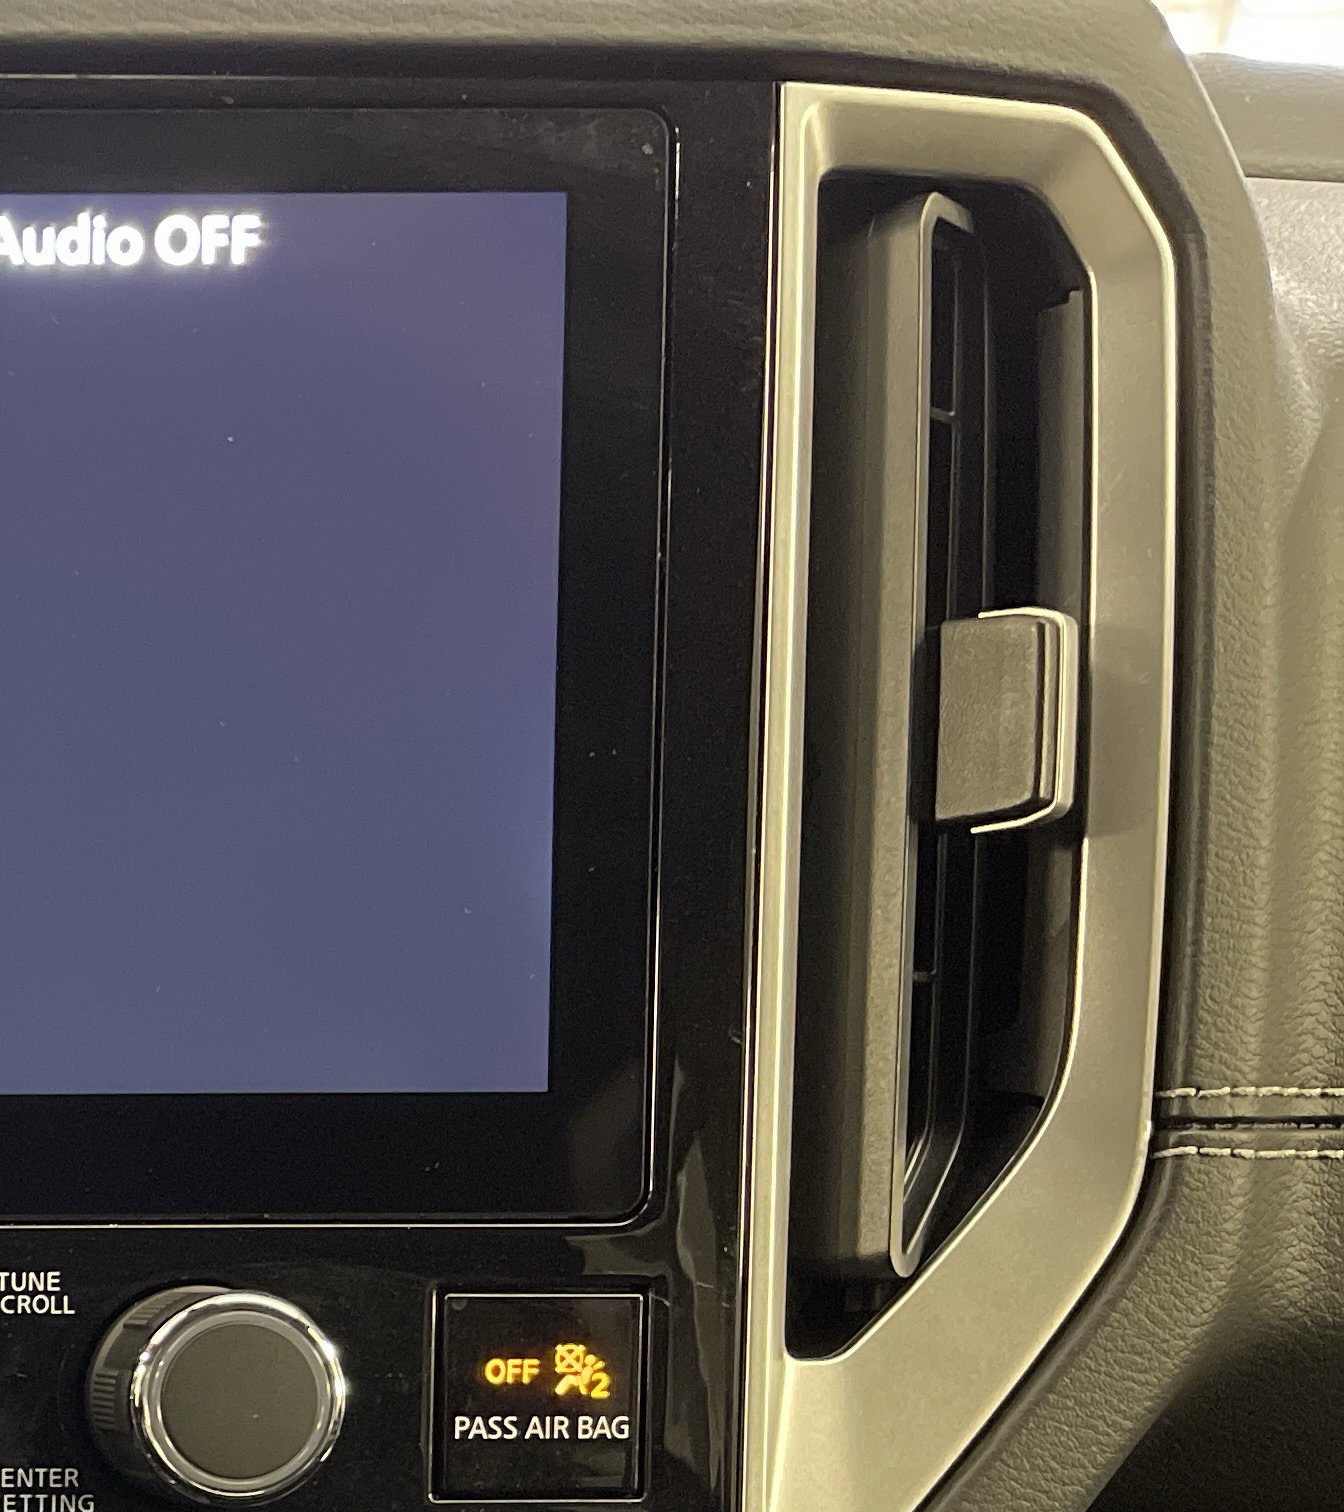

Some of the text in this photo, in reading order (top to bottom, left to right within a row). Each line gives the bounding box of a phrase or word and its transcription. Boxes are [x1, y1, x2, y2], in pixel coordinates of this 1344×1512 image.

[154, 213, 265, 267] OFF
[484, 1358, 541, 1385] OFF
[454, 1416, 630, 1440] PASS AIR BAG
[1, 1468, 79, 1489] ENTER
